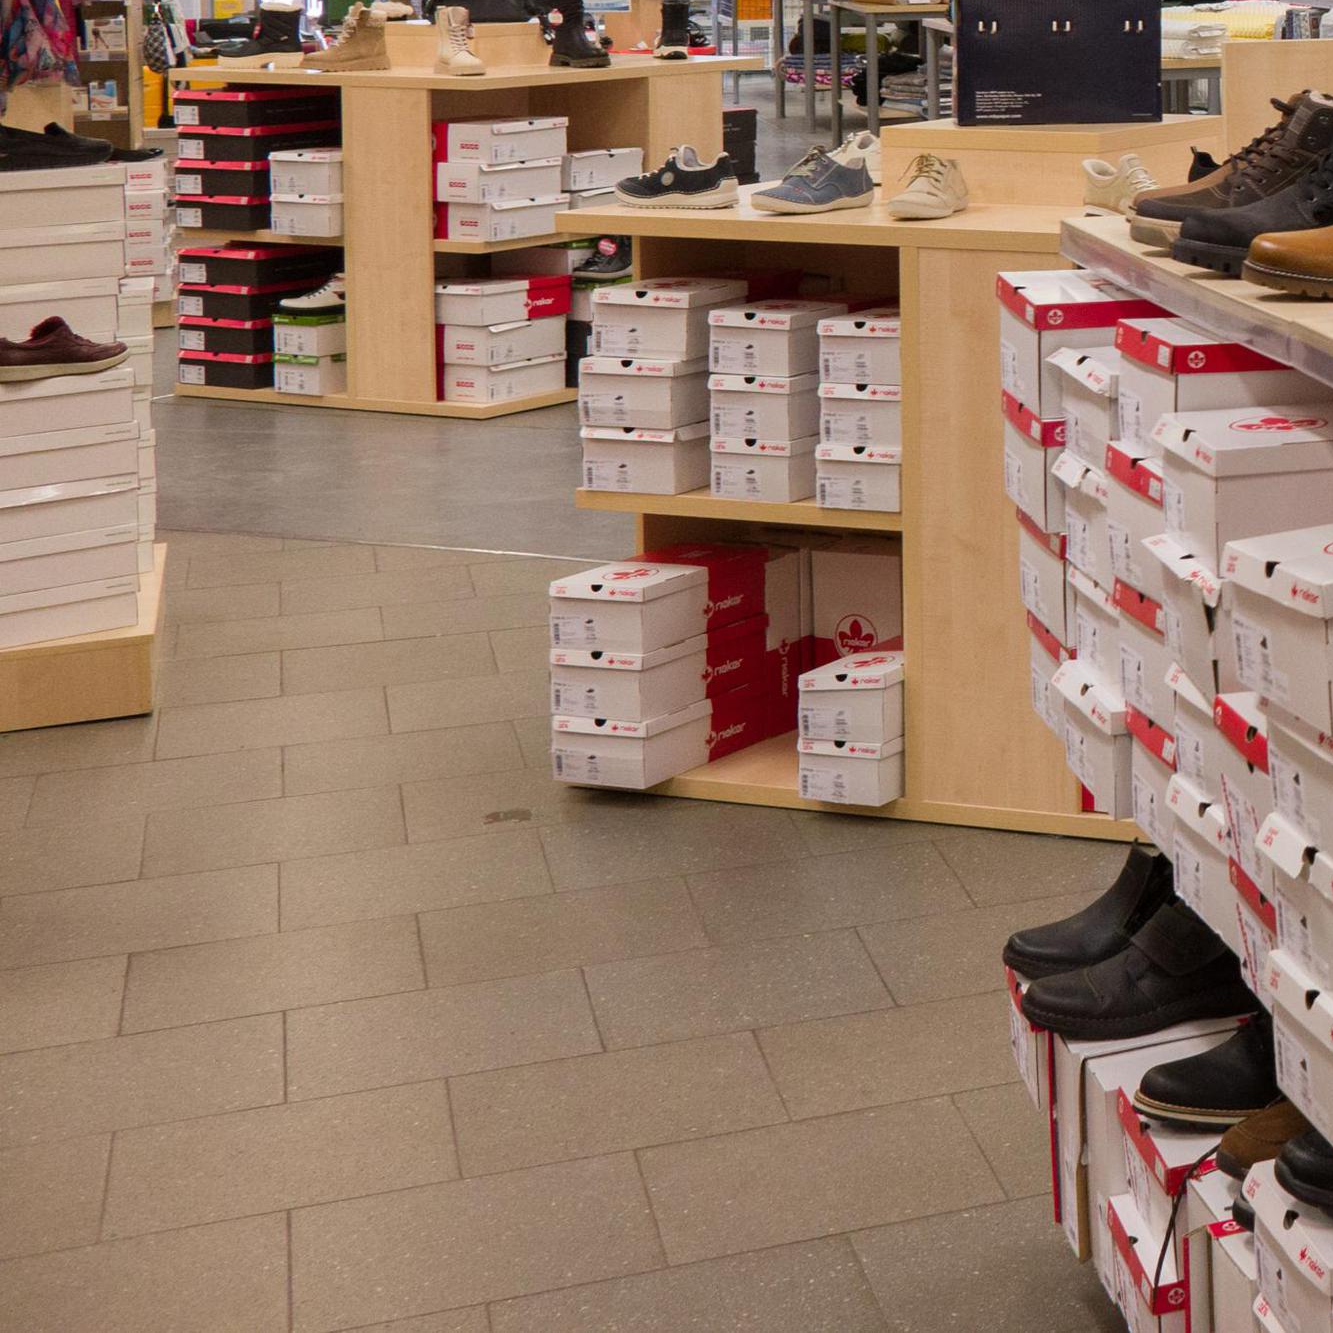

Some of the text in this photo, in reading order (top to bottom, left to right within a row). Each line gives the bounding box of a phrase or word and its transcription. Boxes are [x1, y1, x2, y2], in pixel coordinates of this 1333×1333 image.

[531, 297, 555, 307] rieker
[714, 594, 744, 612] rieker
[843, 638, 871, 648] rieker
[713, 658, 744, 676] rieker
[716, 722, 746, 740] rieker
